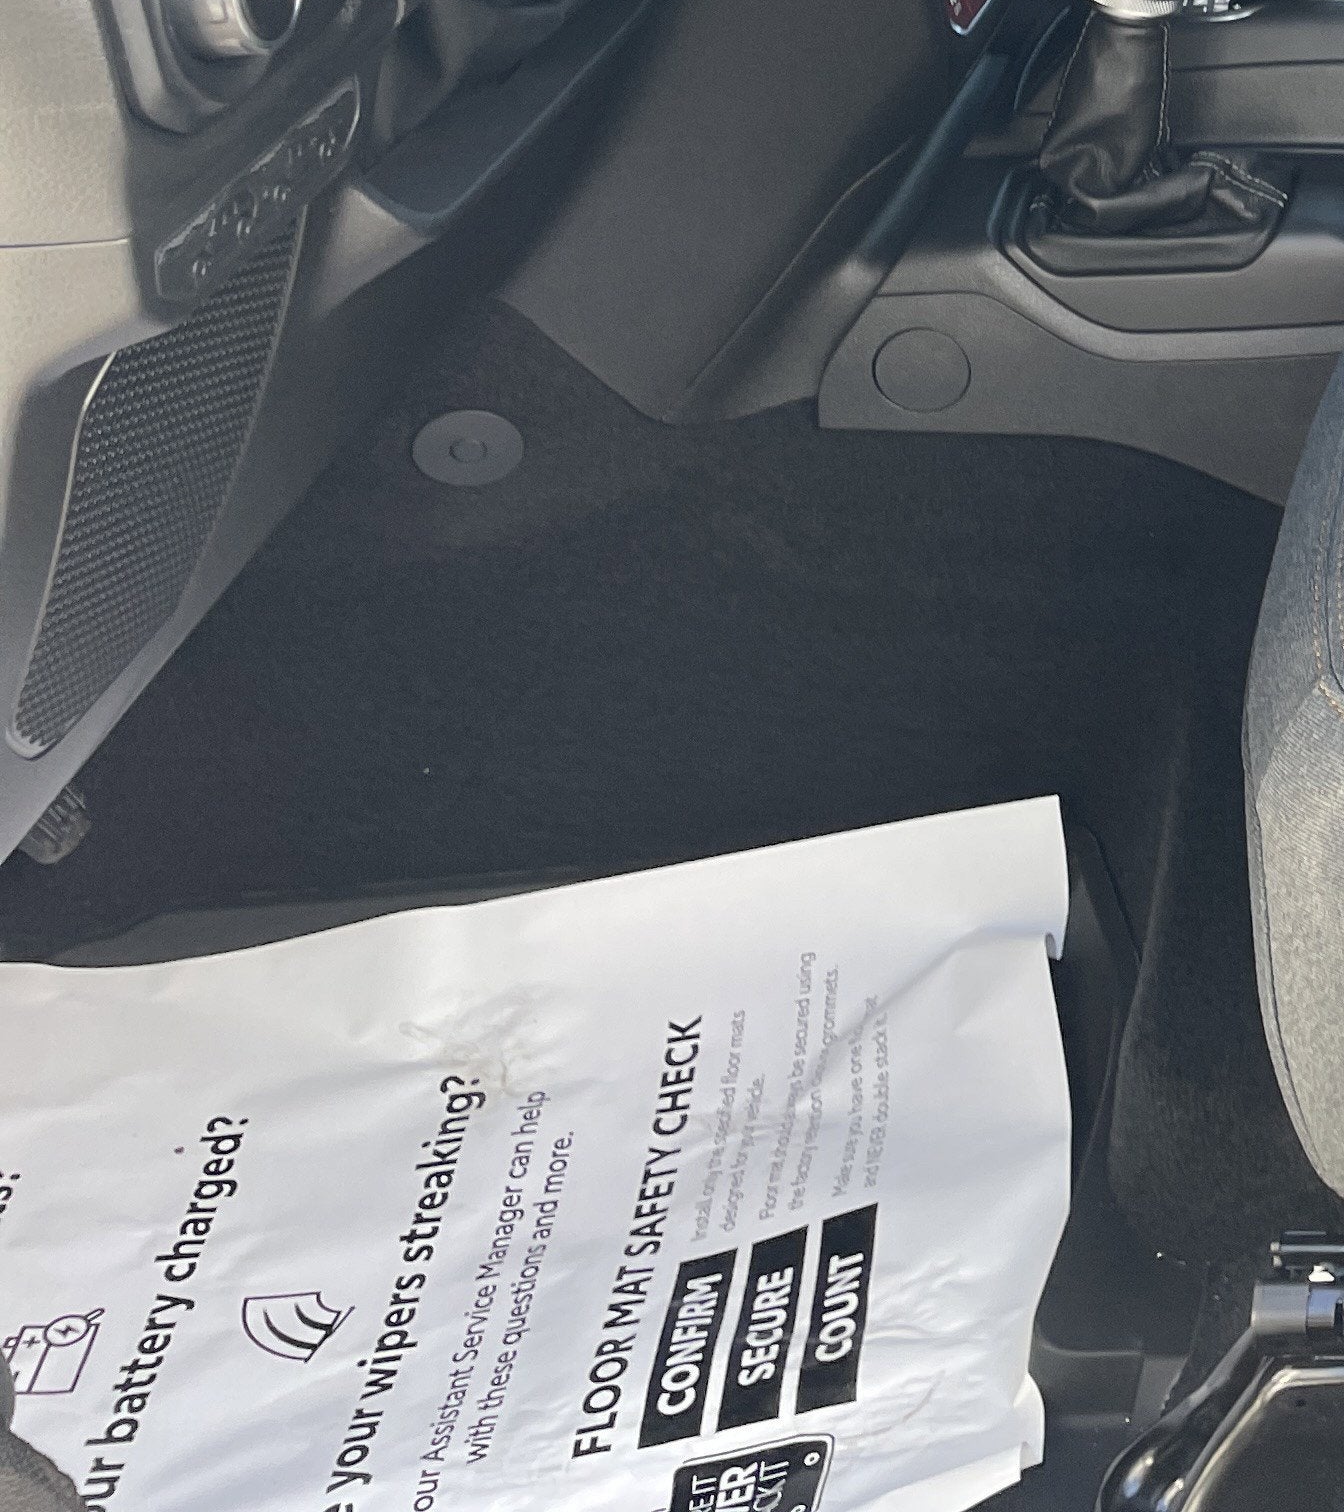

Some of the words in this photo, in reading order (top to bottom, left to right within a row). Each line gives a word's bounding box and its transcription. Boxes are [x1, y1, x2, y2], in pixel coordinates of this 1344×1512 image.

[795, 950, 818, 995] using
[727, 1009, 746, 1049] mats
[788, 997, 811, 1057] secured
[847, 1044, 863, 1075] one
[651, 1014, 703, 1137] CHECK
[842, 1075, 863, 1116] have
[510, 1091, 552, 1137] help
[508, 1140, 534, 1180] can
[543, 1130, 575, 1195] more.
[474, 1185, 526, 1282] Manager
[531, 1199, 560, 1241] and
[623, 1146, 682, 1258] SAFETY
[83, 1293, 196, 1447] battery
[153, 1115, 250, 1283] charged?
[325, 1407, 385, 1495] your
[355, 1272, 428, 1402] wipers
[398, 1075, 487, 1263] streaking?
[501, 1243, 548, 1346] questions
[601, 1264, 656, 1331] MAT
[815, 1253, 863, 1361] COUNT
[451, 1284, 498, 1364] Service
[657, 1274, 723, 1415] CONFIRM
[738, 1267, 794, 1386] SECURE
[476, 1349, 518, 1411] these
[570, 1332, 640, 1460] FLOOR
[419, 1365, 475, 1462] Assistant
[465, 1414, 499, 1467] with
[691, 1474, 718, 1495] IT
[758, 1460, 791, 1482] IT
